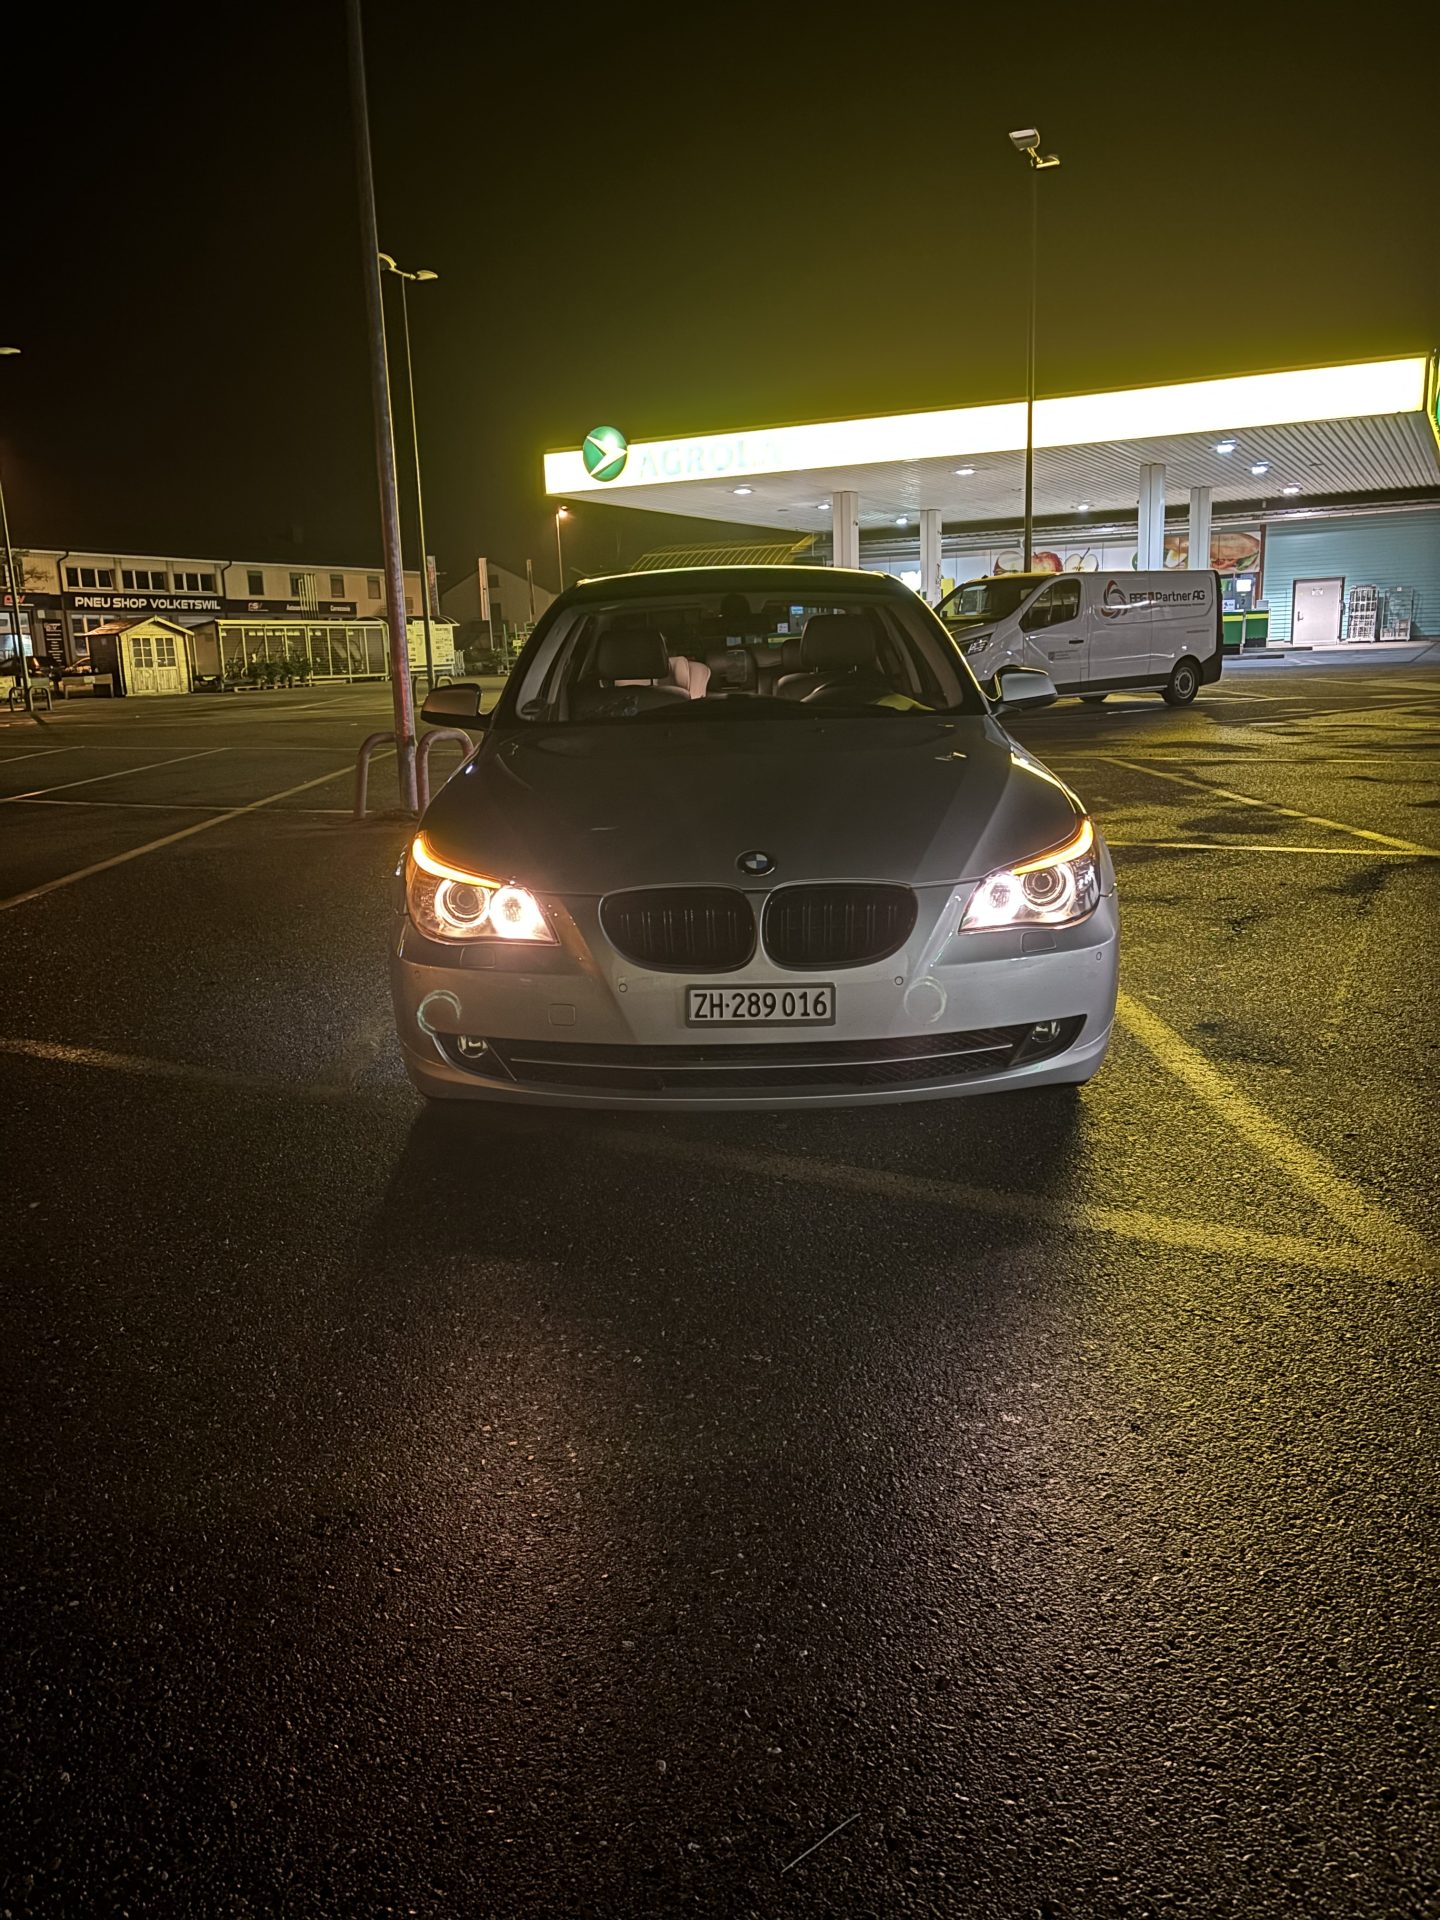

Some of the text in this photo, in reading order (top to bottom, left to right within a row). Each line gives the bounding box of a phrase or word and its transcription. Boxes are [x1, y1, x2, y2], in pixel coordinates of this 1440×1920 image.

[640, 439, 783, 479] AGROLA
[74, 596, 221, 610] PNEU SHOP VOLKETSWIL
[1155, 591, 1192, 602] Partner
[1192, 590, 1206, 601] AG
[782, 990, 828, 1018] 016
